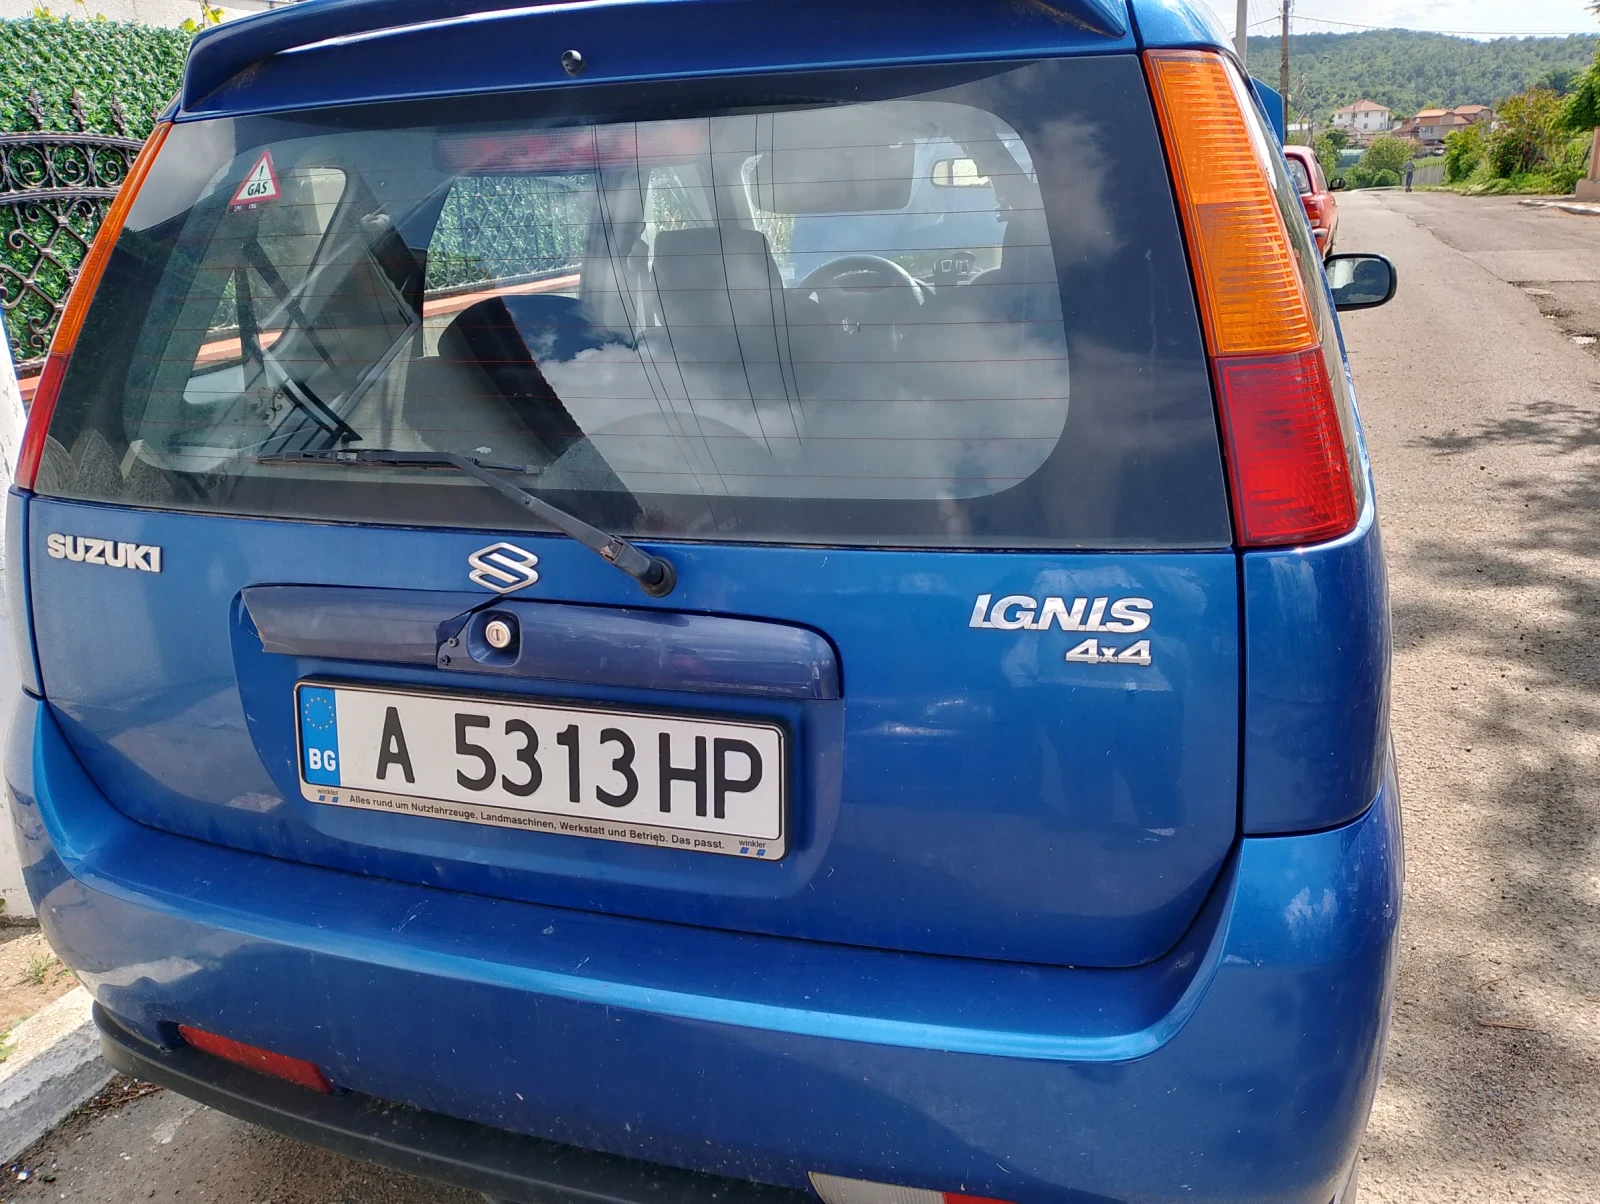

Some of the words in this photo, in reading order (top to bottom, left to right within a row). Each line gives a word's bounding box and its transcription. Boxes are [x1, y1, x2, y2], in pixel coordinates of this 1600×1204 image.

[247, 181, 268, 196] GAS
[47, 532, 162, 573] SUZUKI
[968, 593, 1154, 634] IGNIS
[1065, 638, 1152, 666] 4x4
[308, 747, 337, 772] BG
[376, 706, 416, 784] A
[454, 713, 639, 808] 5313
[658, 732, 763, 819] HP
[316, 788, 339, 796] winkler
[349, 795, 371, 805] Alles
[372, 799, 393, 808] rund
[395, 802, 409, 811] um
[411, 802, 478, 820] Nutzfahrzeuge,
[480, 811, 557, 830] Landmaschinen,
[560, 821, 606, 836] Werkstatt
[607, 828, 627, 838] und
[629, 829, 669, 843] Betrieb.
[671, 835, 691, 845] Das
[694, 838, 725, 849] passt.
[738, 839, 766, 849] winkler
